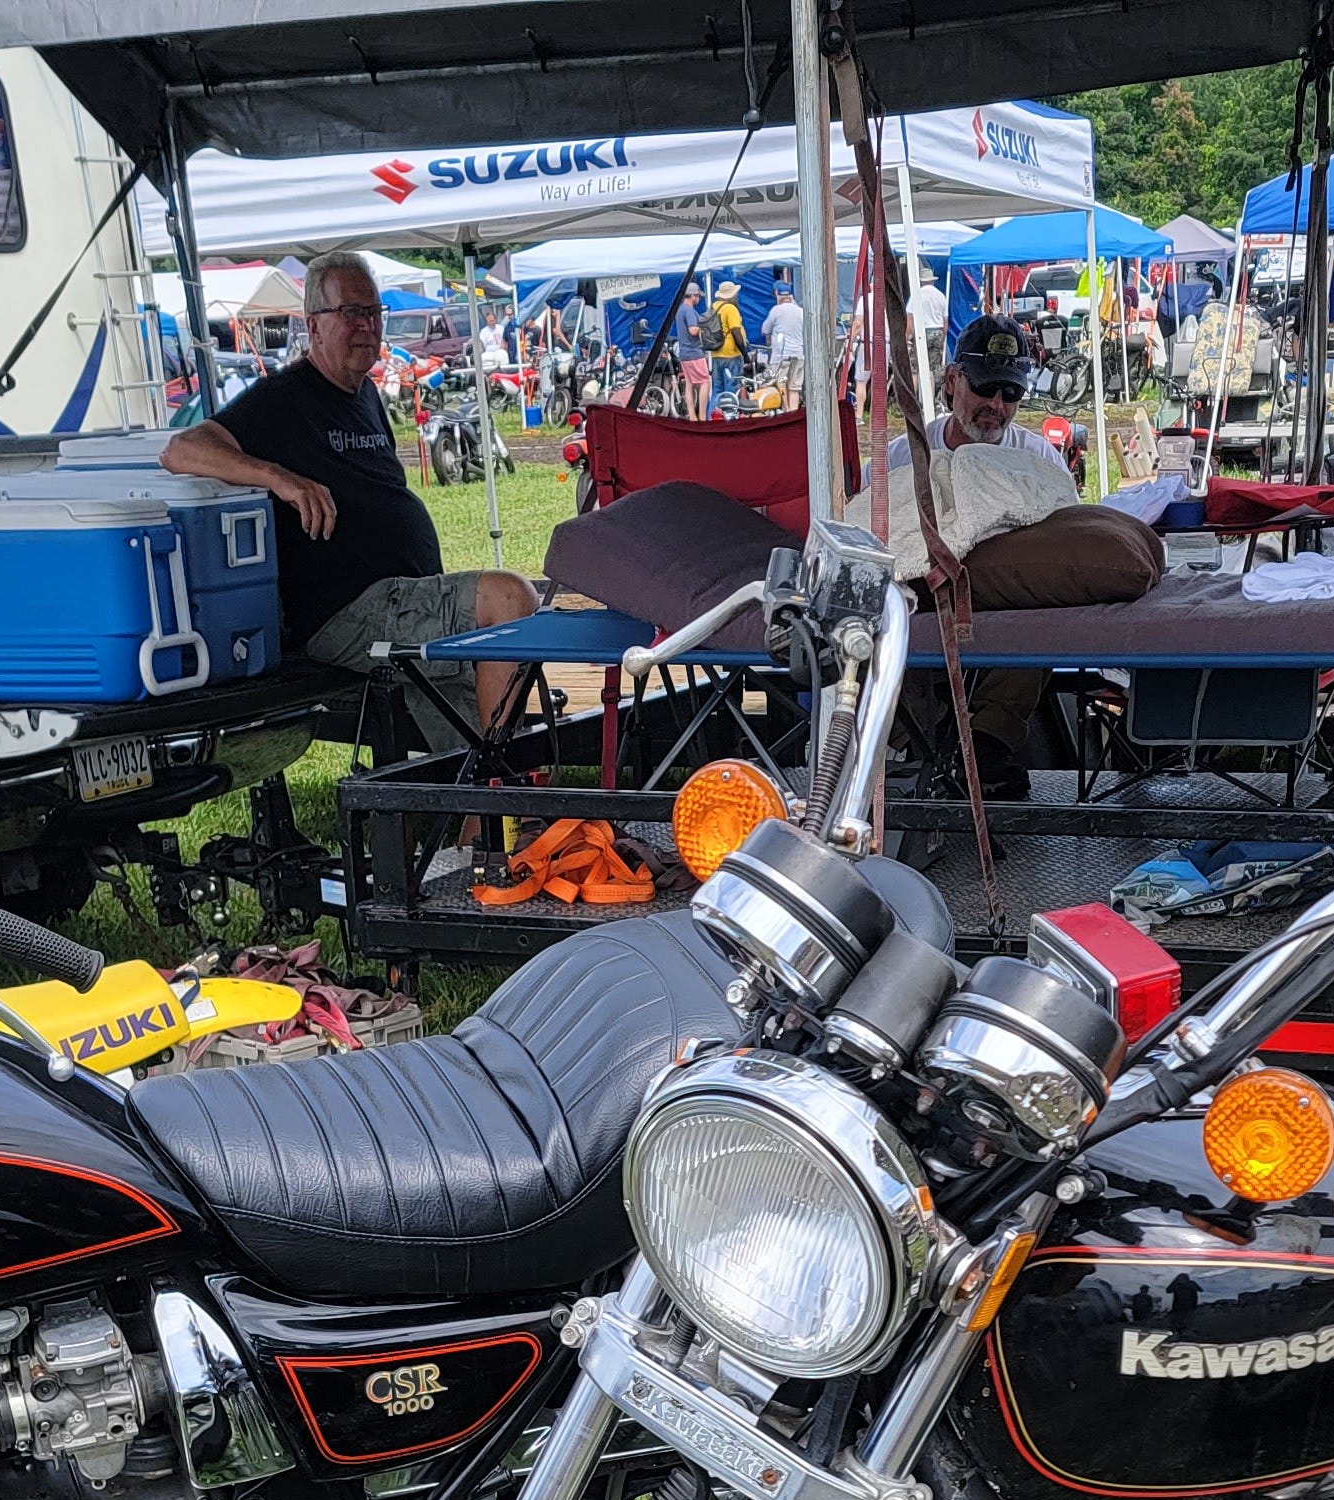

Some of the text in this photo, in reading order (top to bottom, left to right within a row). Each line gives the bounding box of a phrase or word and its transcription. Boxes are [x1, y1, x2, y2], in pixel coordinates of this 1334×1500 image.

[428, 137, 627, 189] SUZUKI
[987, 121, 1040, 167] SUZUKI
[539, 175, 632, 201] Way of Life!
[366, 1363, 448, 1404] CSR
[384, 1395, 435, 1417] 1000
[646, 1389, 765, 1483] Kawasaki
